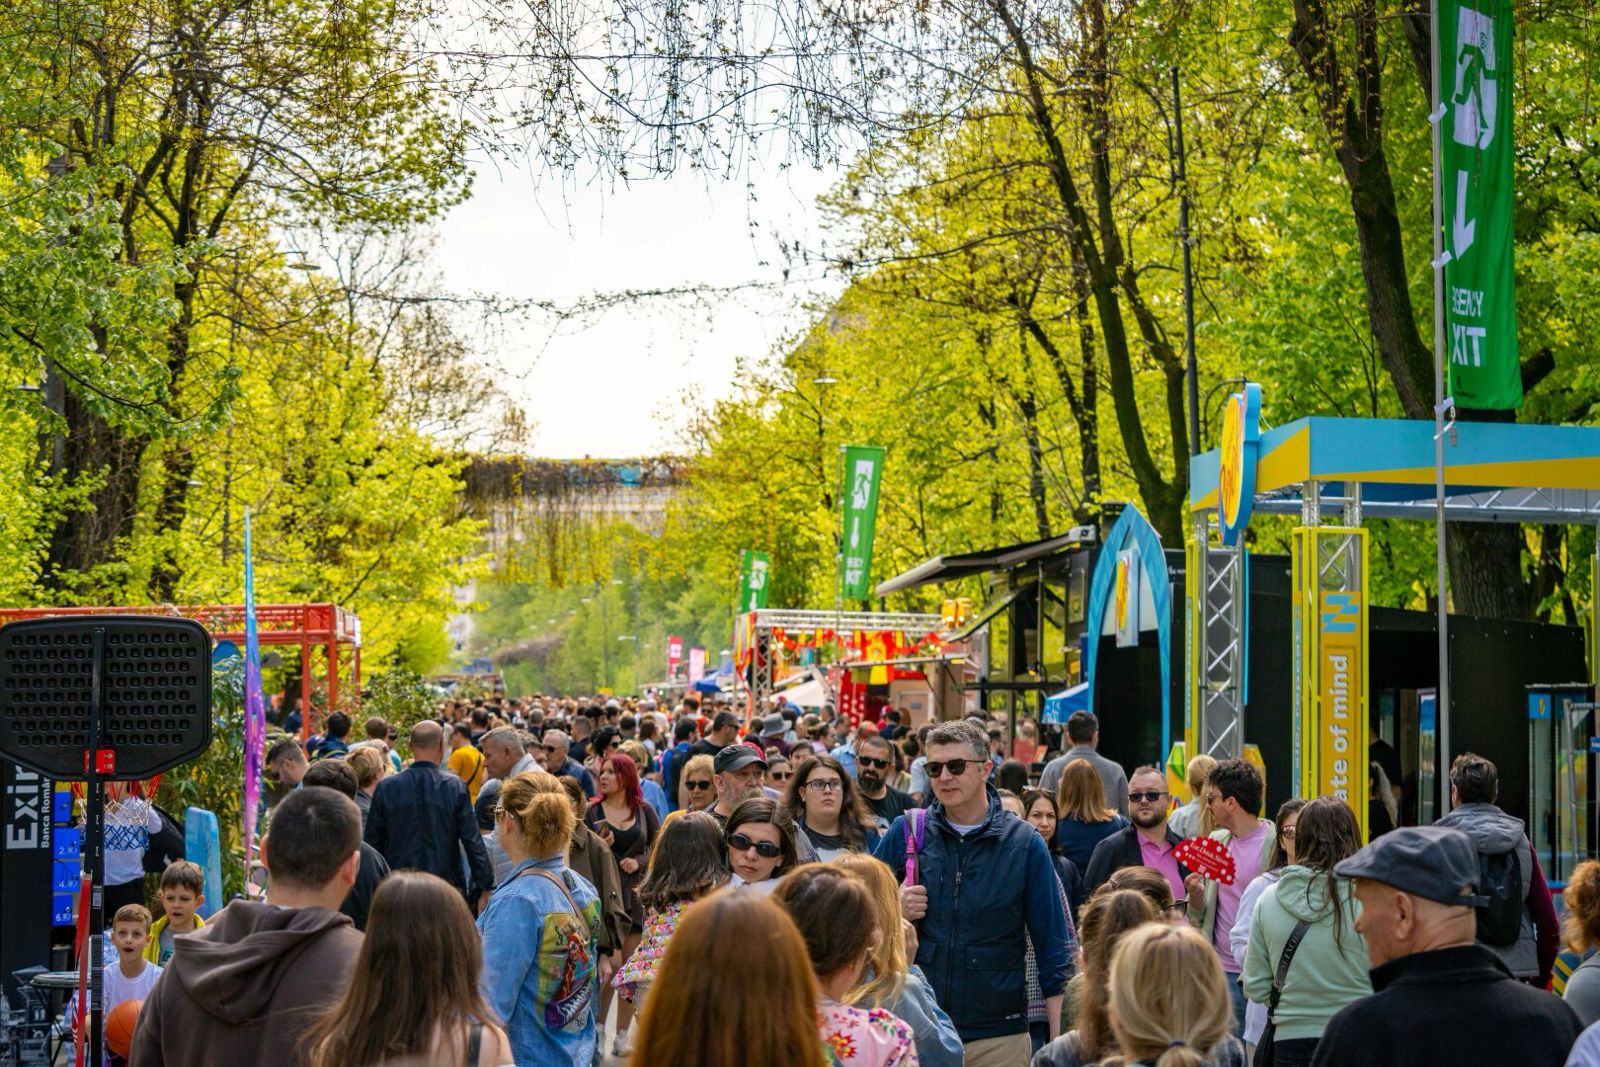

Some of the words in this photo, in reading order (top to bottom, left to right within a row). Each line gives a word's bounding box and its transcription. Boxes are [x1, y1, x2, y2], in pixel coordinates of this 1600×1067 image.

[1452, 322, 1486, 368] XIT
[1329, 655, 1348, 718] mind
[1329, 724, 1348, 752] of
[1330, 759, 1348, 802] ate
[41, 815, 50, 849] Banca
